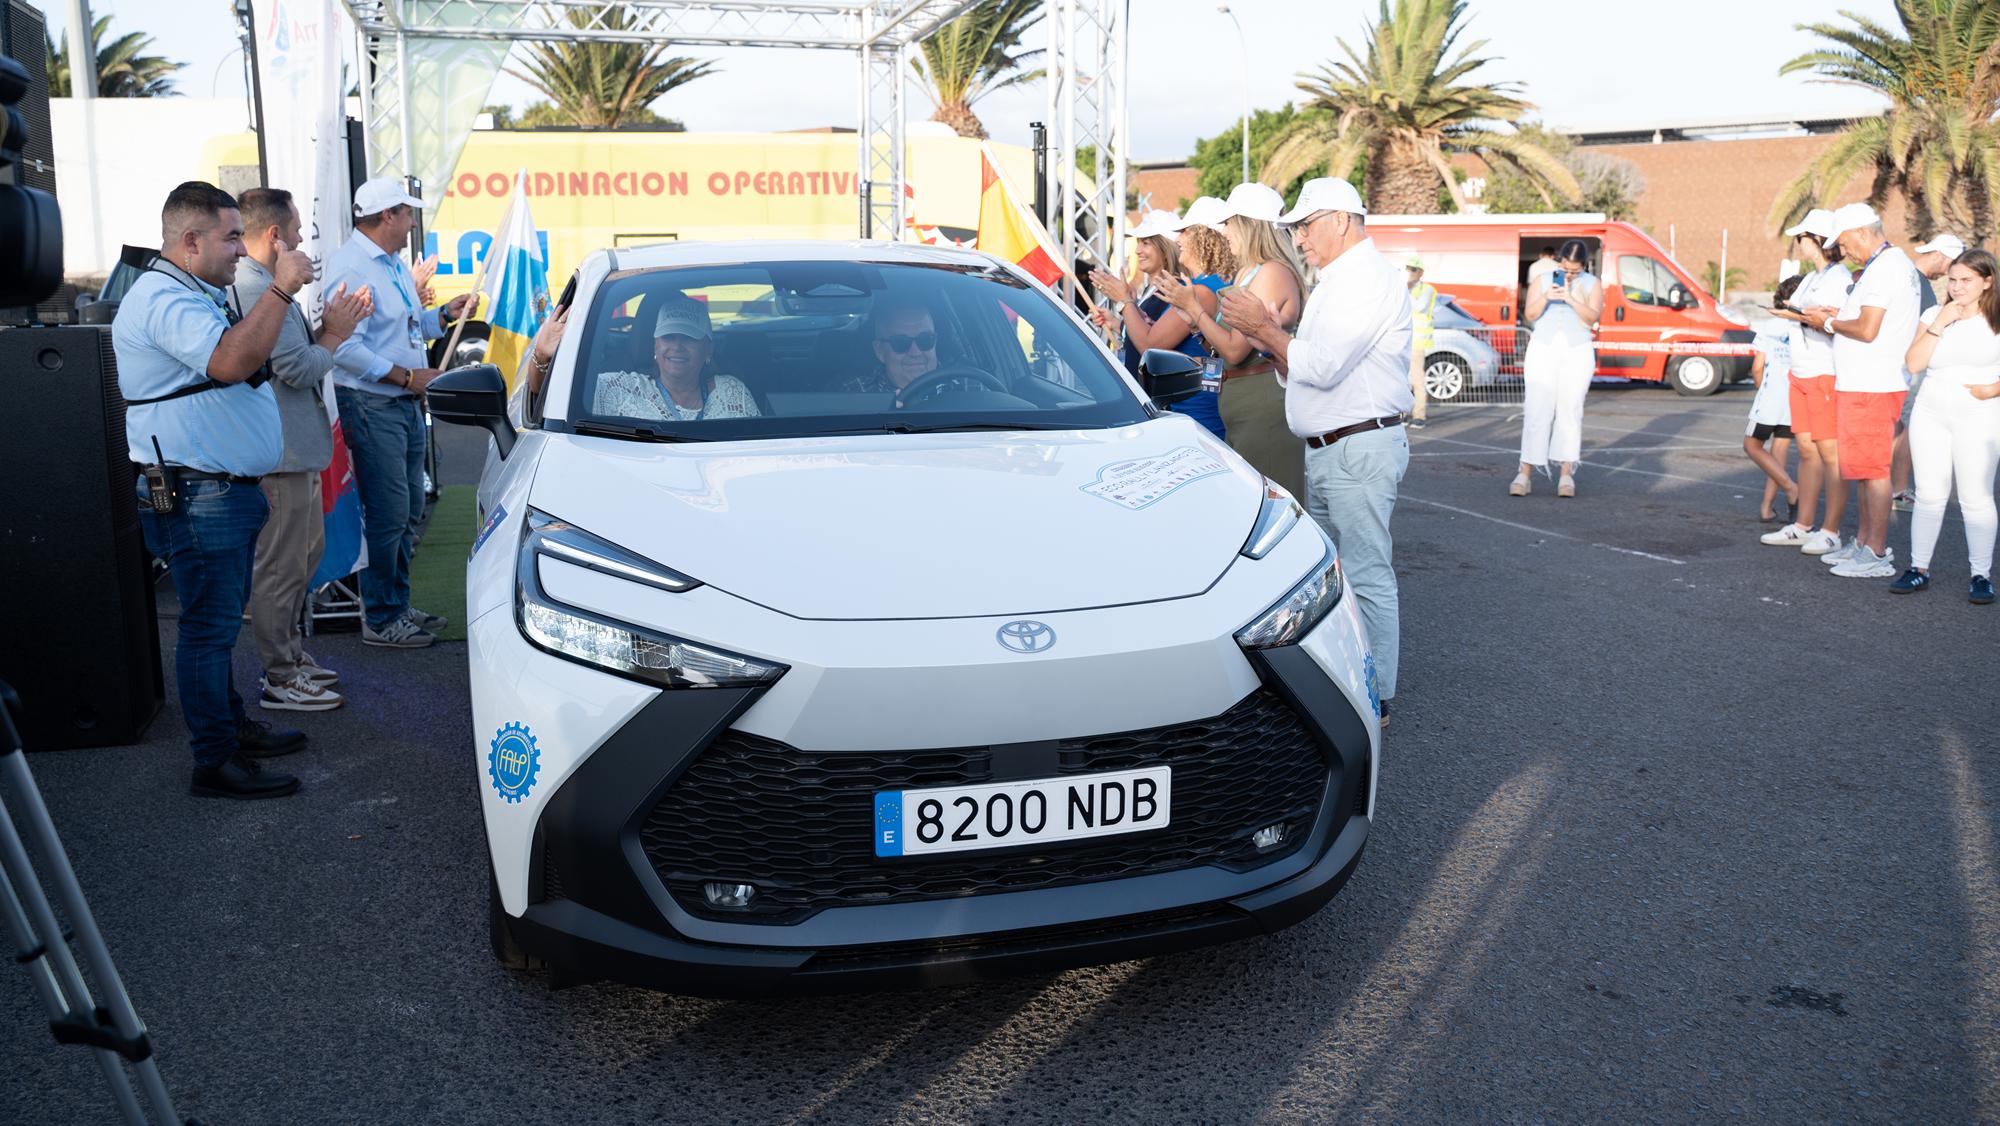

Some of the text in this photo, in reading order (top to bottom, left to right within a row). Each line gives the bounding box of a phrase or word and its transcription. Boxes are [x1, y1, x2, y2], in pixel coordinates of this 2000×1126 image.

[707, 171, 858, 196] OPERATIV
[916, 777, 1158, 844] 8200 NDB
[883, 830, 895, 844] E
